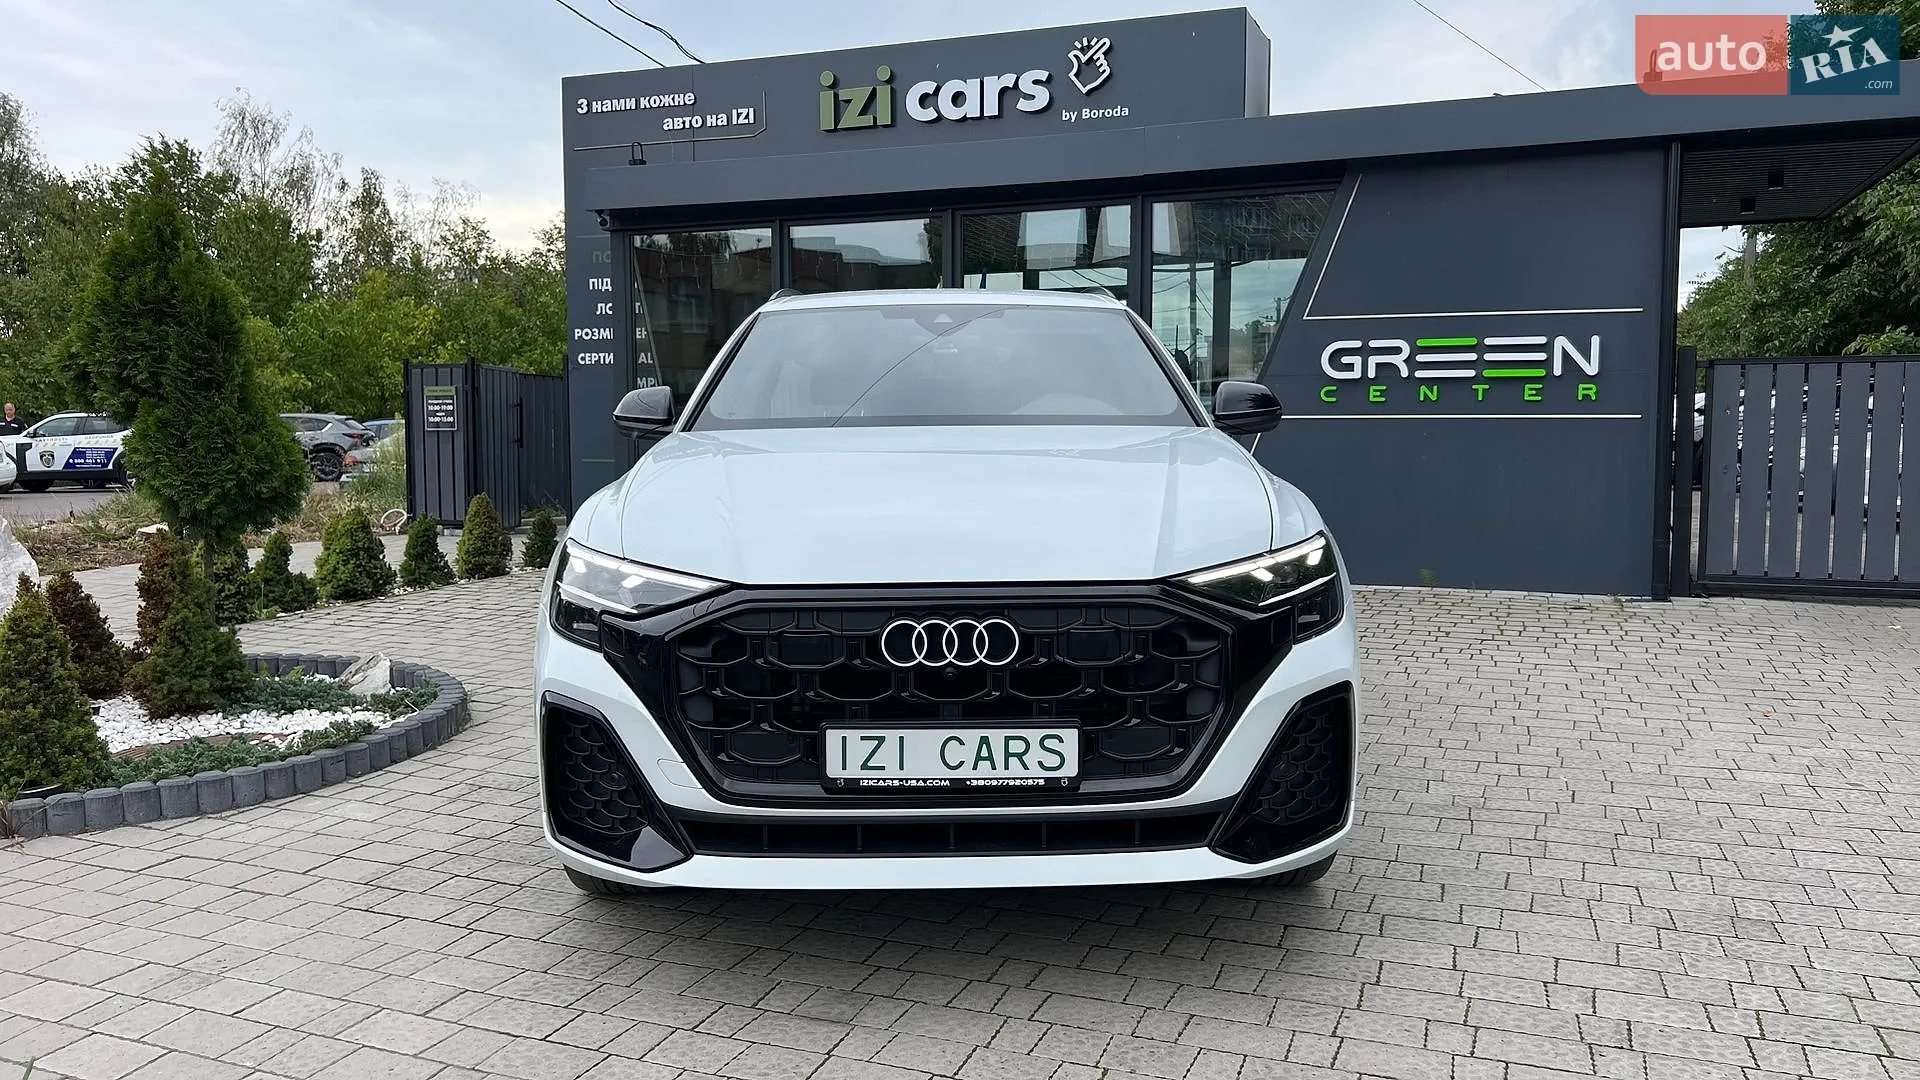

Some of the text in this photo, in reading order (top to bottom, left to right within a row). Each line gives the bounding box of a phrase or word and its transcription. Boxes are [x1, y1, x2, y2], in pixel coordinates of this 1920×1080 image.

[592, 98, 636, 113] нами
[639, 92, 696, 109] кожне
[819, 65, 1051, 131] izi cars
[662, 107, 755, 130] авто на IZI
[1061, 105, 1130, 122] by Boroda
[1319, 334, 1600, 379] GREEN
[1319, 384, 1598, 402] CENTER
[841, 733, 1066, 772] IZI CARS
[860, 779, 950, 787] IZICARS-USA.COM
